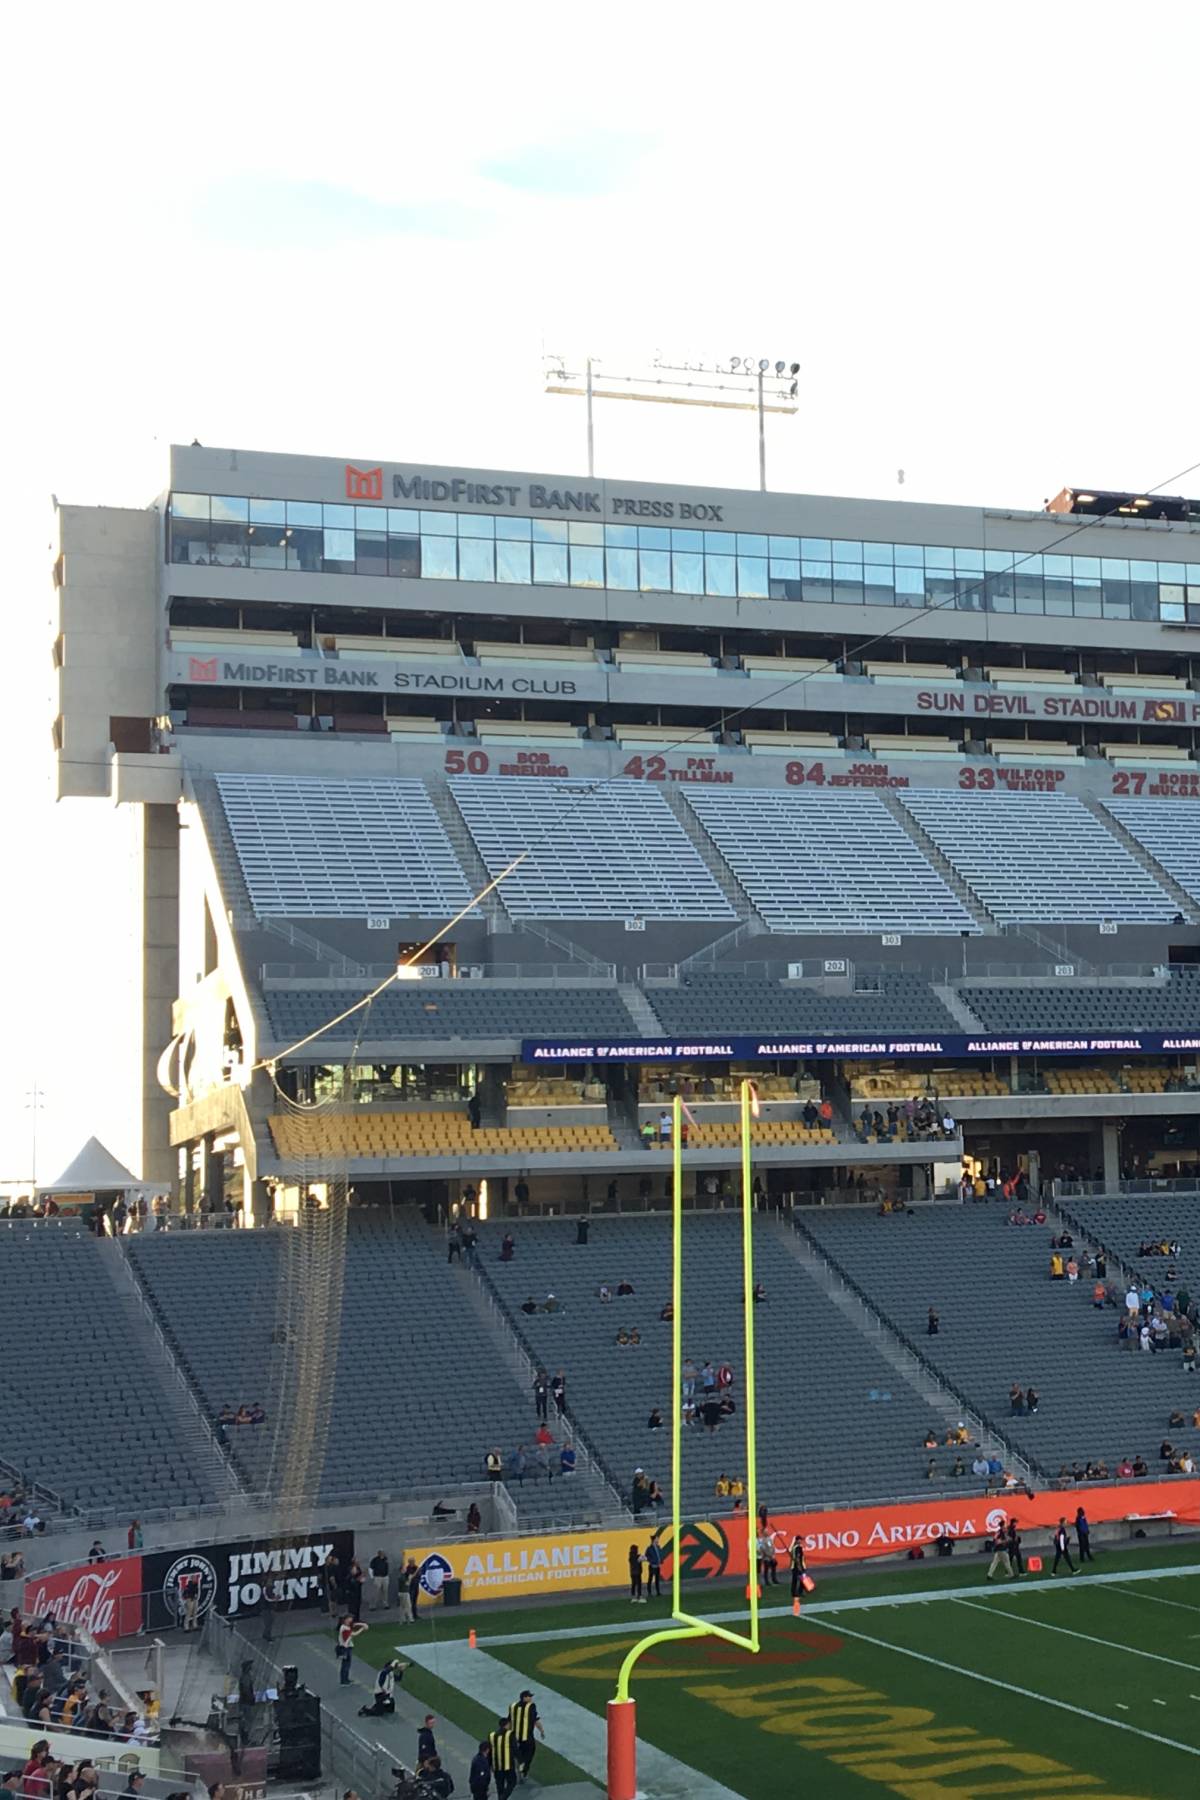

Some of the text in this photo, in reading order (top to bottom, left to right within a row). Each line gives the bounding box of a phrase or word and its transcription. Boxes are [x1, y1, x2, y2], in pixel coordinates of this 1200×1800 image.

[612, 498, 674, 518] PRESS
[679, 503, 724, 522] BOX
[394, 672, 504, 693] STADIUM
[512, 677, 577, 696] CLUB
[917, 692, 964, 712] SUN
[974, 694, 1035, 715] DEVIL
[1043, 697, 1137, 718] STADIUM
[444, 750, 489, 776] 50
[517, 752, 550, 765] BOB
[687, 758, 716, 770] PAT
[624, 755, 667, 782] 42
[785, 761, 826, 787] 84
[848, 763, 888, 776] JOHN
[996, 768, 1066, 782] WILFORD
[668, 769, 733, 784] TILLMAN
[827, 775, 909, 789] JEFFERSON
[958, 767, 996, 791] 33
[1112, 772, 1147, 796] 27
[370, 919, 389, 929] 301
[627, 920, 644, 930] 302
[1101, 923, 1117, 933] 304
[883, 935, 900, 946] 303
[420, 966, 438, 977] 201
[826, 961, 844, 971] 202
[1056, 966, 1073, 976] 203
[534, 1047, 594, 1057] ALLIANCE
[609, 1046, 672, 1056] AMERICAN
[676, 1046, 734, 1056] FOOTBALL
[758, 1045, 813, 1054] ALLIANCE
[827, 1043, 886, 1053] AMERICAN
[889, 1043, 943, 1053] FOOTBALL
[968, 1041, 1019, 1051] ALLIANCE
[1033, 1041, 1088, 1050] AMERICAN
[1091, 1040, 1141, 1049] FOOTBALL
[770, 1521, 975, 1555] CSINO ARIZONA
[228, 1544, 334, 1583] JIMMY
[464, 1543, 608, 1576] ALLIANCE
[475, 1571, 544, 1588] AMERICAN
[547, 1566, 610, 1581] FOOTBALL
